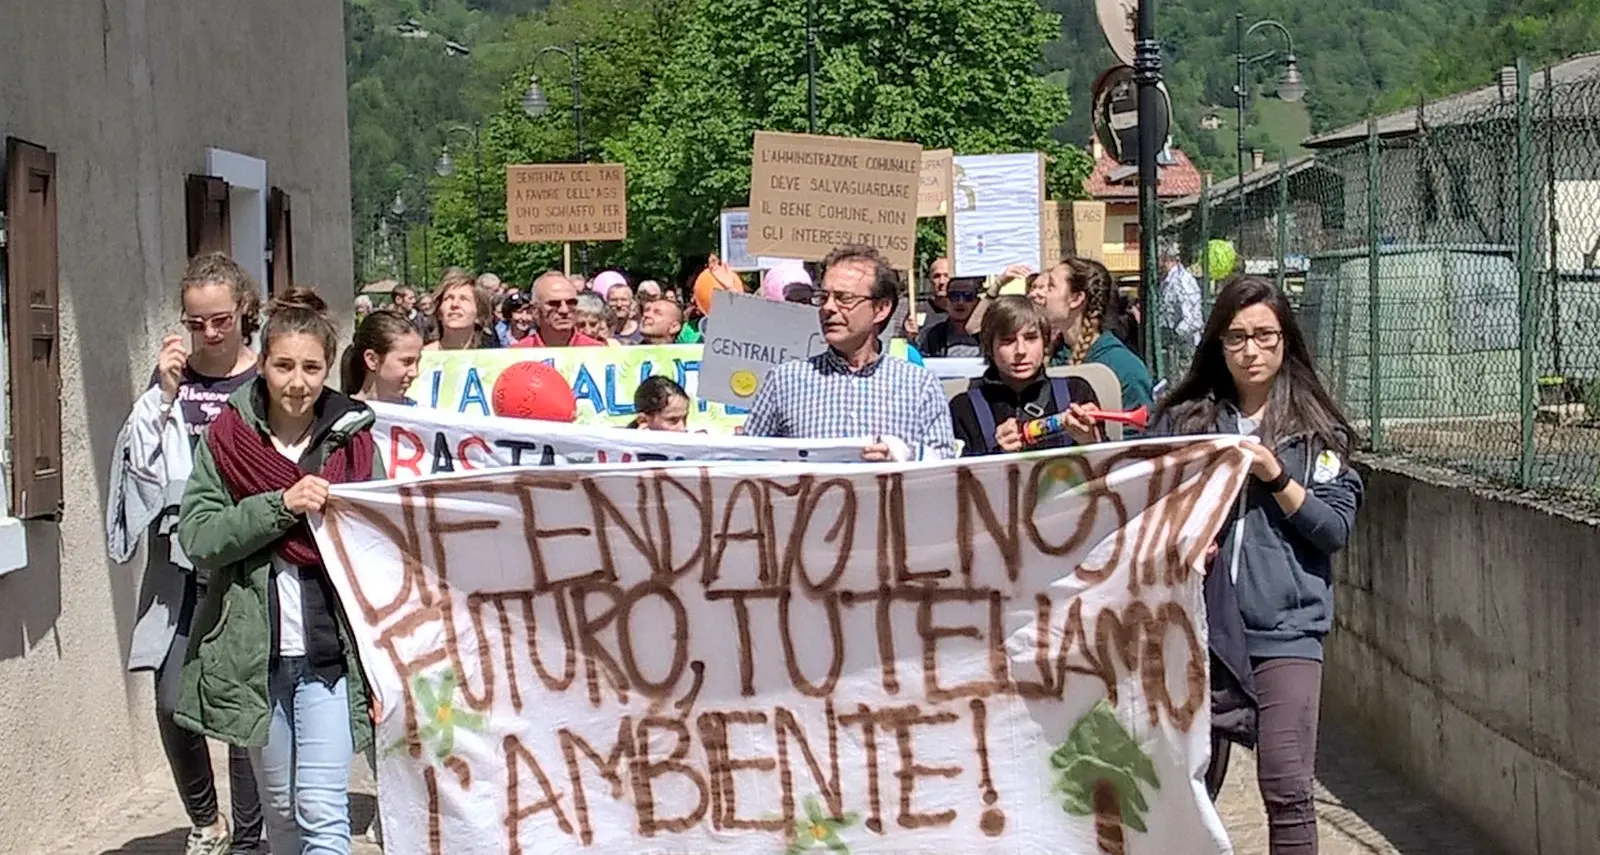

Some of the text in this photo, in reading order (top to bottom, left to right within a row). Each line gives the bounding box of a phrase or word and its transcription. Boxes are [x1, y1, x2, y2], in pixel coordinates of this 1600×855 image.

[761, 149, 859, 169] L'AMMINISTRAZIONE
[865, 156, 917, 173] COMUNALE
[516, 169, 566, 184] SENTENZA
[571, 169, 592, 182] DEL
[770, 174, 801, 191] DEVE
[810, 178, 910, 199] SALVAGUARDARE
[515, 189, 524, 200] A
[526, 188, 560, 201] FAVORE
[516, 203, 621, 219] UNO SCHIAFFO PER
[761, 201, 906, 225] IL BENE COMUNE, NON
[529, 222, 563, 236] DIRITTO
[567, 222, 590, 235] ALLA
[592, 220, 624, 234] SALUTE
[762, 225, 784, 241] GLI
[857, 232, 909, 251] DELL'AGS
[326, 466, 858, 626] DIFENDIAMO
[875, 472, 952, 583] IL
[374, 579, 706, 759] FUTURO,
